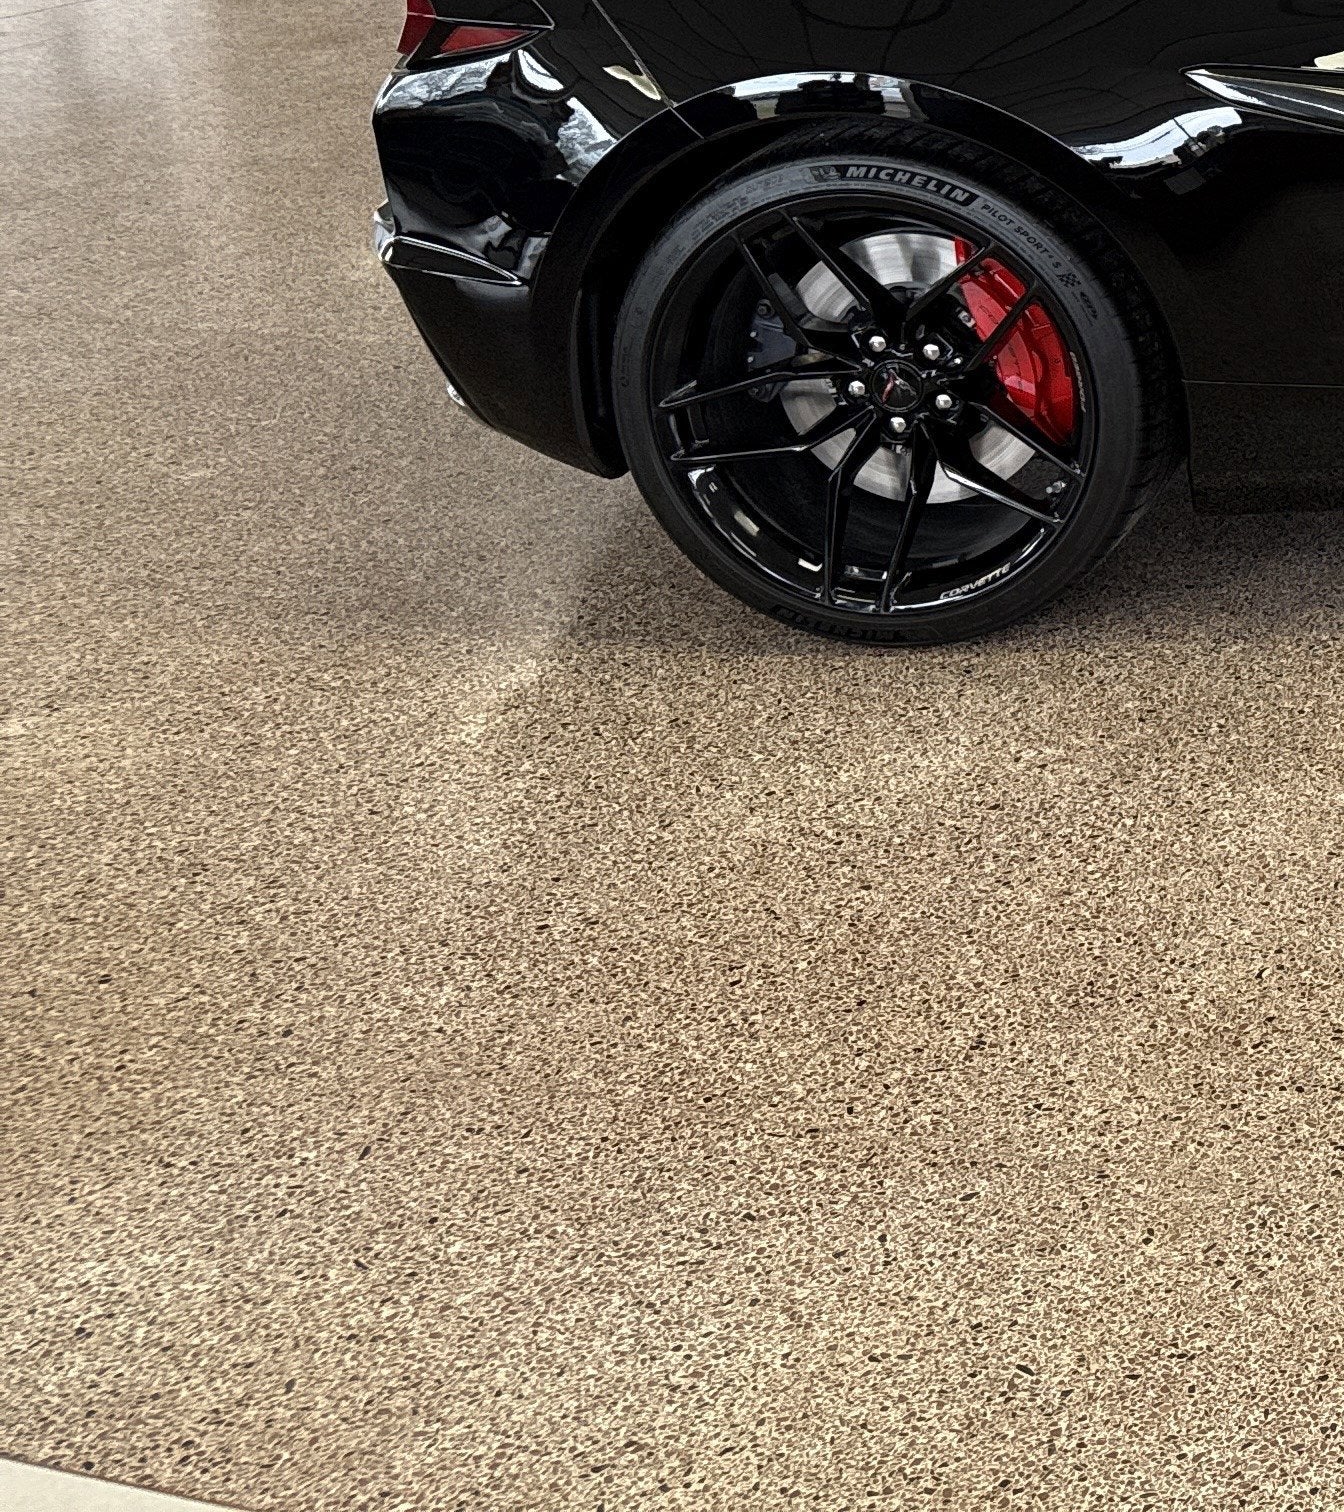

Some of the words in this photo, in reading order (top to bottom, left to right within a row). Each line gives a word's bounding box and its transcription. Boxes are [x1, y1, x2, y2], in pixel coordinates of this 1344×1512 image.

[846, 166, 971, 203] MICHELIN
[980, 203, 1013, 227] PILOT
[1014, 224, 1050, 256] SPORT
[940, 562, 1011, 600] CORVETTE
